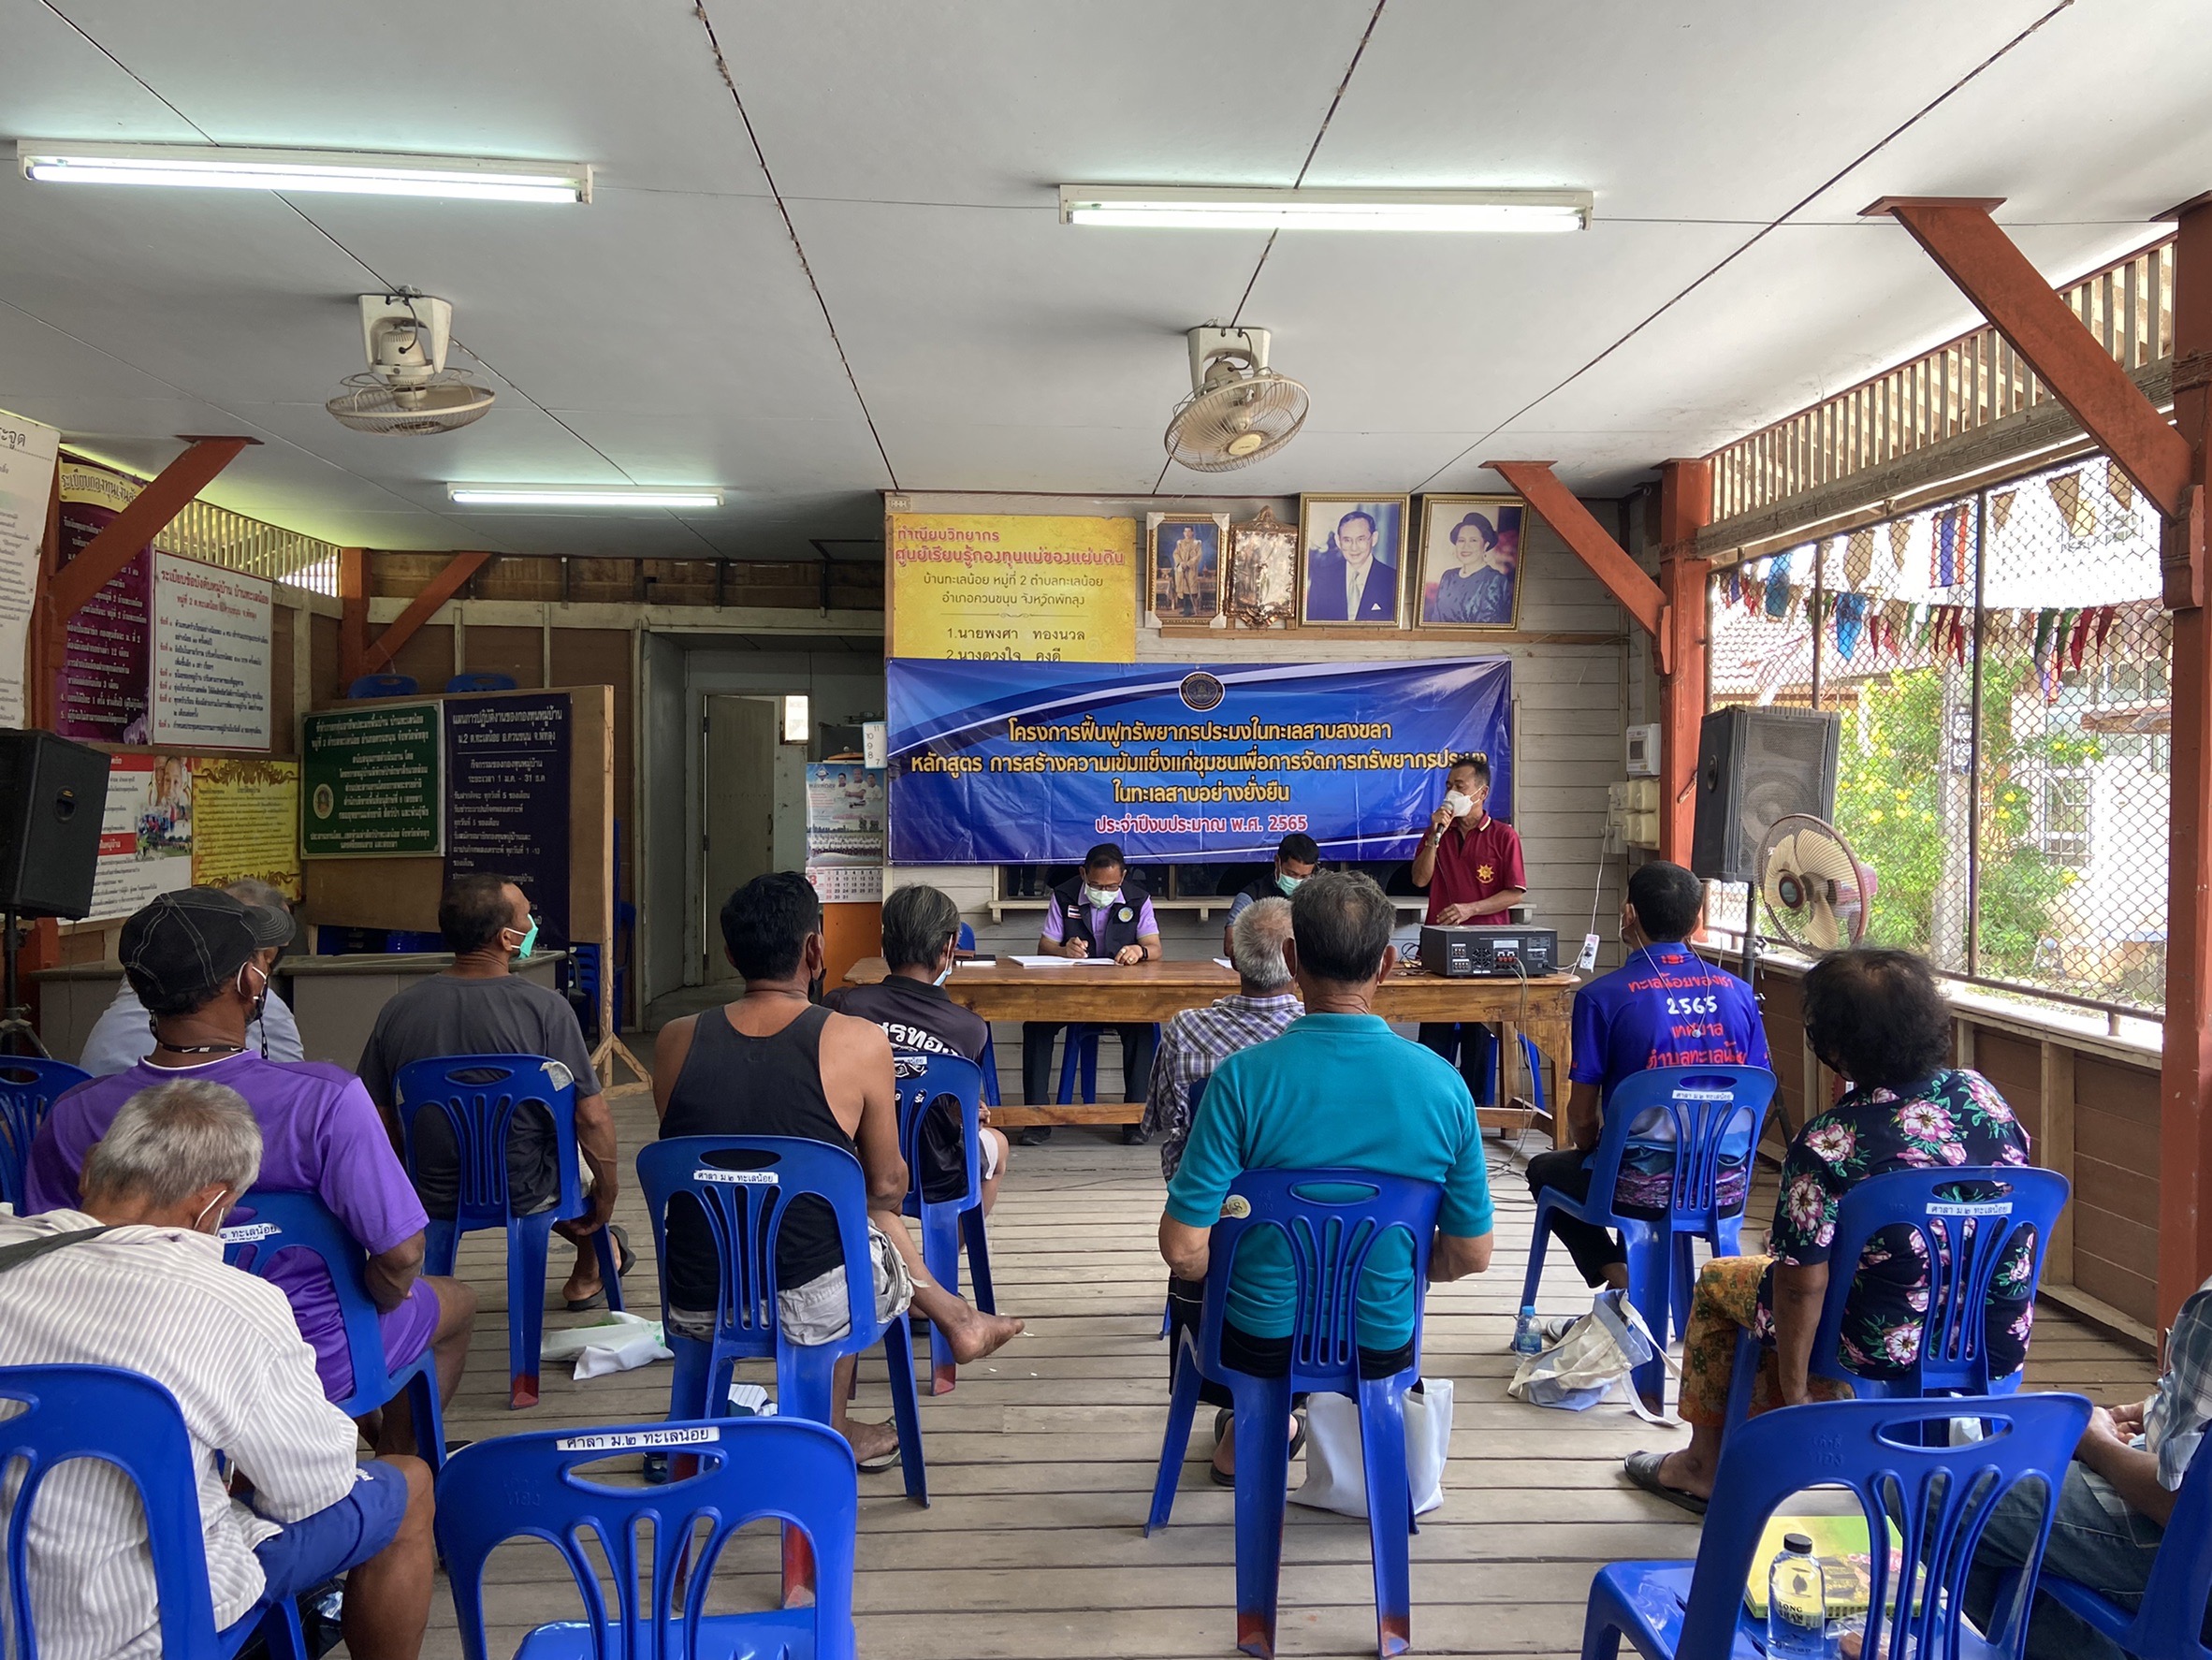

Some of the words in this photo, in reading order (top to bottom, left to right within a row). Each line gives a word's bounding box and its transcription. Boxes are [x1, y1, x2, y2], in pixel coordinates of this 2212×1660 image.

[897, 525, 1000, 542] ทำเนียบวิทยากร
[895, 545, 1125, 569] ศูนย์เรียนรู้กองทุนแม่ของแผ่นดิน
[923, 573, 990, 586] บ้านทะเลน้อย
[993, 570, 1016, 589] หมู่ที่
[1020, 575, 1026, 586] 2
[1030, 573, 1104, 587] ตำบลทะเลน้อย
[189, 597, 193, 605] 2
[941, 591, 1018, 609] อำเภอควนขนุน
[1021, 591, 1085, 607] จังหวัดพัทลุง
[947, 626, 1019, 640] 1.นายพงศา
[1032, 627, 1085, 642] ทองนวล
[452, 706, 562, 728] แผนการปฏิบัติงานของกองทุนหมู่บ้าน
[1008, 715, 1392, 748] โครงการฟื้นฟูทรัพยากรประมงในทะเลสาบสงขลา
[911, 750, 982, 779] หลักสูตร
[1113, 775, 1290, 803] ในทะเลสาบอย่างยั่งยืน
[1095, 812, 1226, 834] ประจำปีงบประมาณ
[1230, 815, 1263, 832] พ.ศ.
[1269, 814, 1308, 831] 2565
[1628, 972, 1734, 993] ทะเลน้อยของเรา
[1666, 995, 1718, 1015] 2565
[737, 1173, 773, 1183] ทะเลน้อย
[1973, 1204, 2008, 1214] ทะเลน้อย
[231, 1225, 277, 1238] ทะเลน้อย
[566, 1437, 604, 1449] ศาลา
[611, 1435, 636, 1447] ม.๒
[643, 1427, 709, 1445] ทะเลน้อย
[1779, 1601, 1803, 1613] LONG
